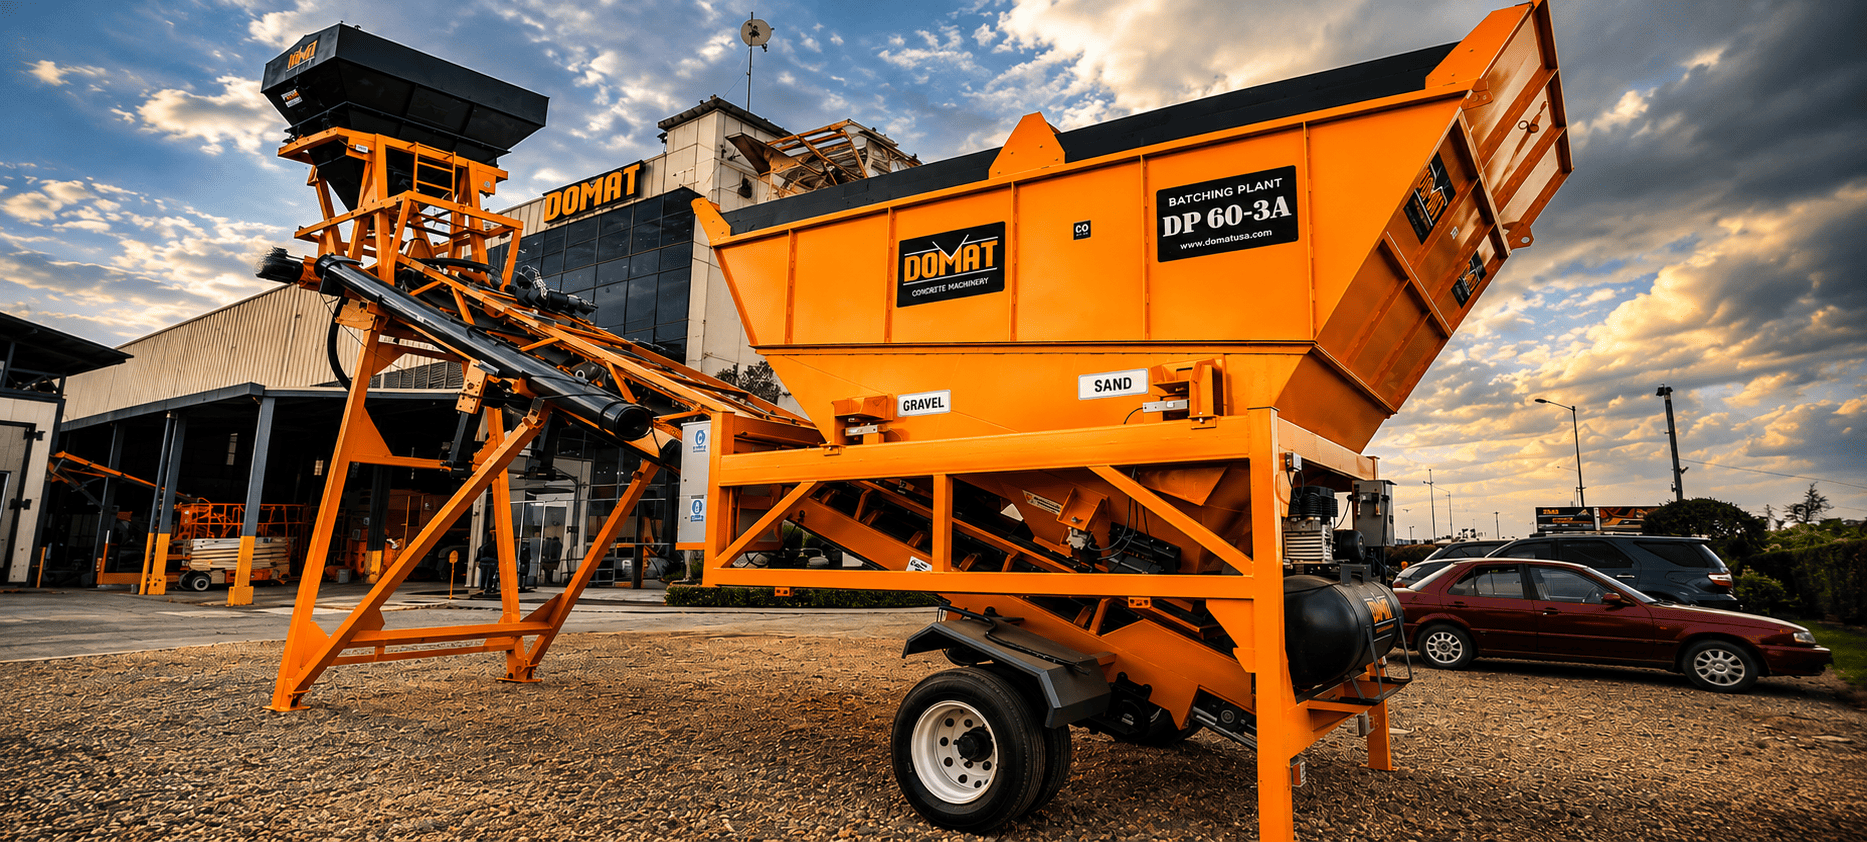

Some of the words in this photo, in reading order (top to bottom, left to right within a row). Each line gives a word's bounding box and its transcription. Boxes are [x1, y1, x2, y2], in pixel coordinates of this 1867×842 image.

[544, 163, 640, 223] DOMAT
[1168, 187, 1233, 207] BATCHING
[1237, 178, 1283, 195] PLANT
[1162, 211, 1202, 237] DP
[1207, 195, 1292, 229] 60-3A
[1180, 229, 1273, 250] www.domatusa.com
[903, 240, 998, 282] DOMAT
[948, 277, 989, 291] MACHINERY
[1094, 376, 1132, 393] SAND
[903, 396, 945, 412] GRAVEL
